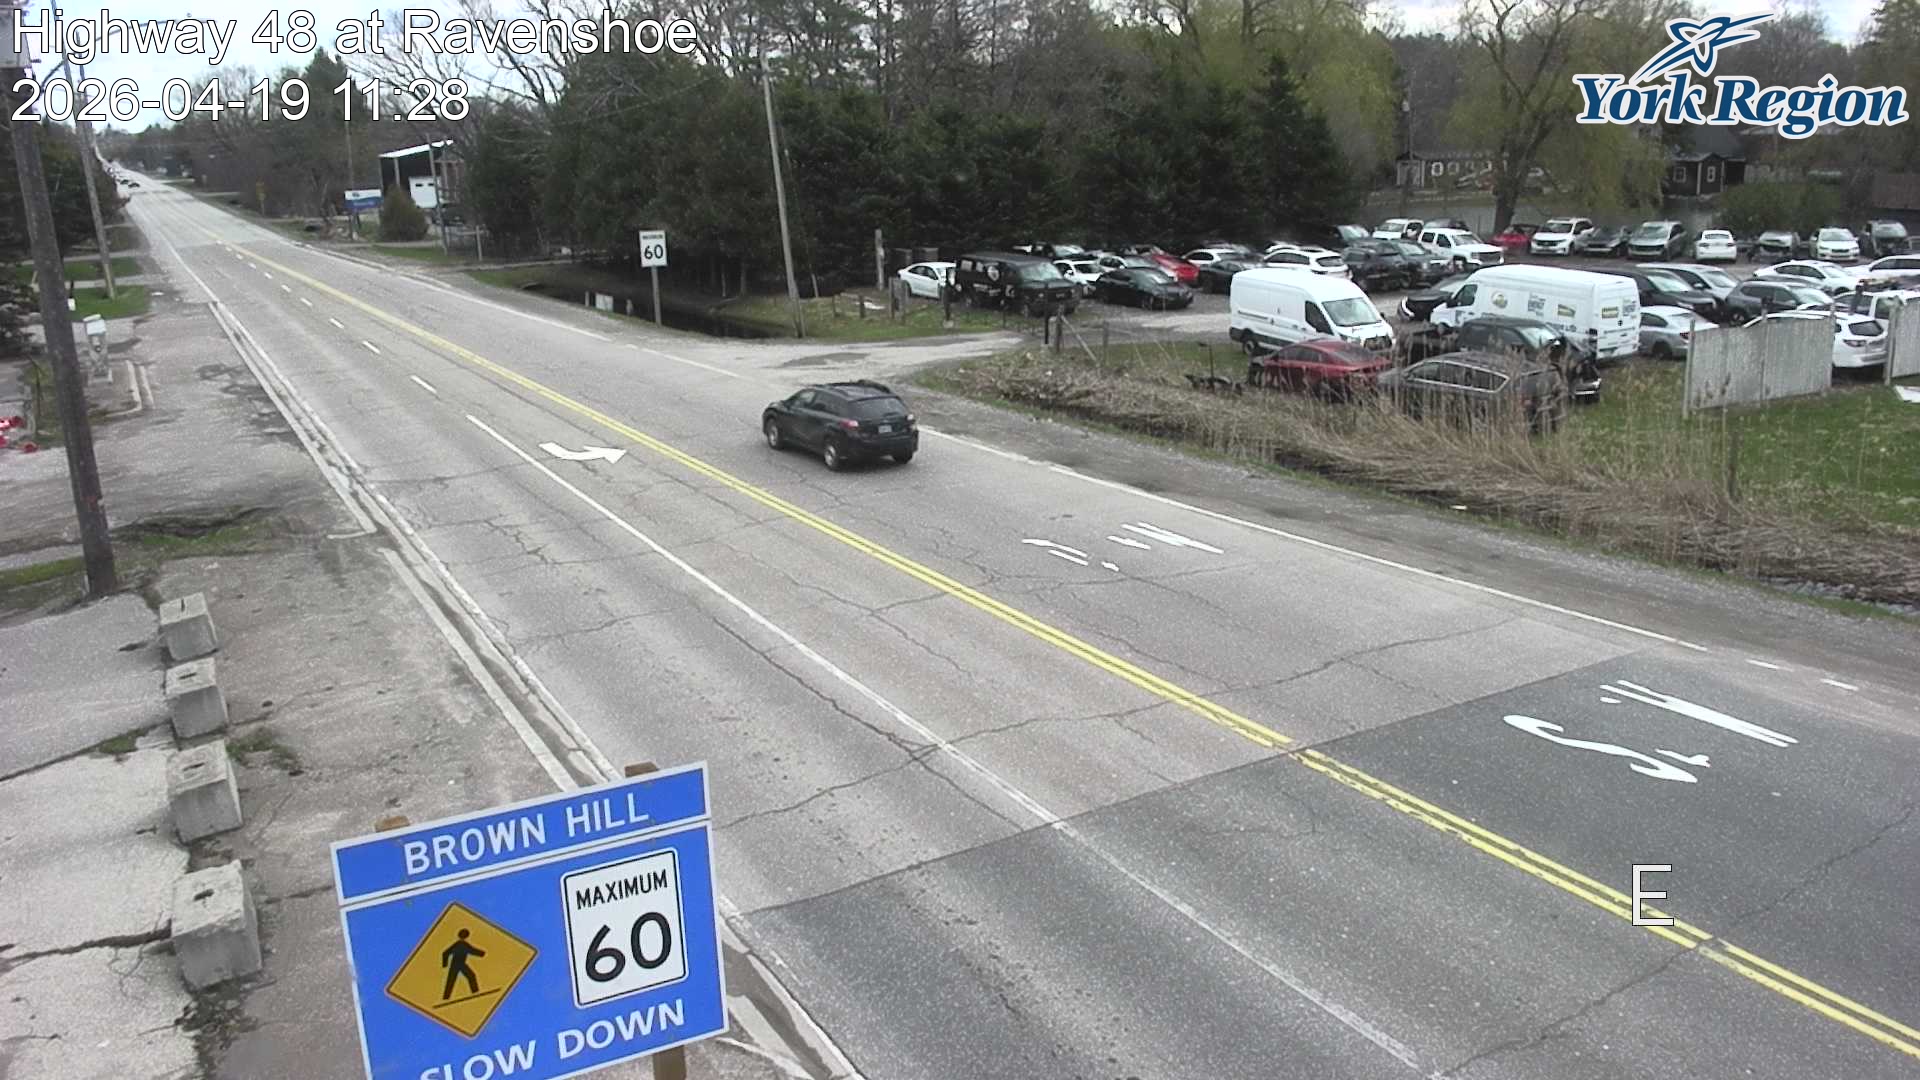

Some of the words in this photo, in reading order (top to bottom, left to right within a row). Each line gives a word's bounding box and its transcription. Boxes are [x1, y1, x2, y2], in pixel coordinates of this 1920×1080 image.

[644, 243, 664, 260] 60
[403, 813, 547, 875] BROWN
[566, 793, 650, 837] HILL
[576, 869, 668, 910] MAXIMUM
[584, 911, 672, 983] 60
[558, 999, 685, 1059] DOWN
